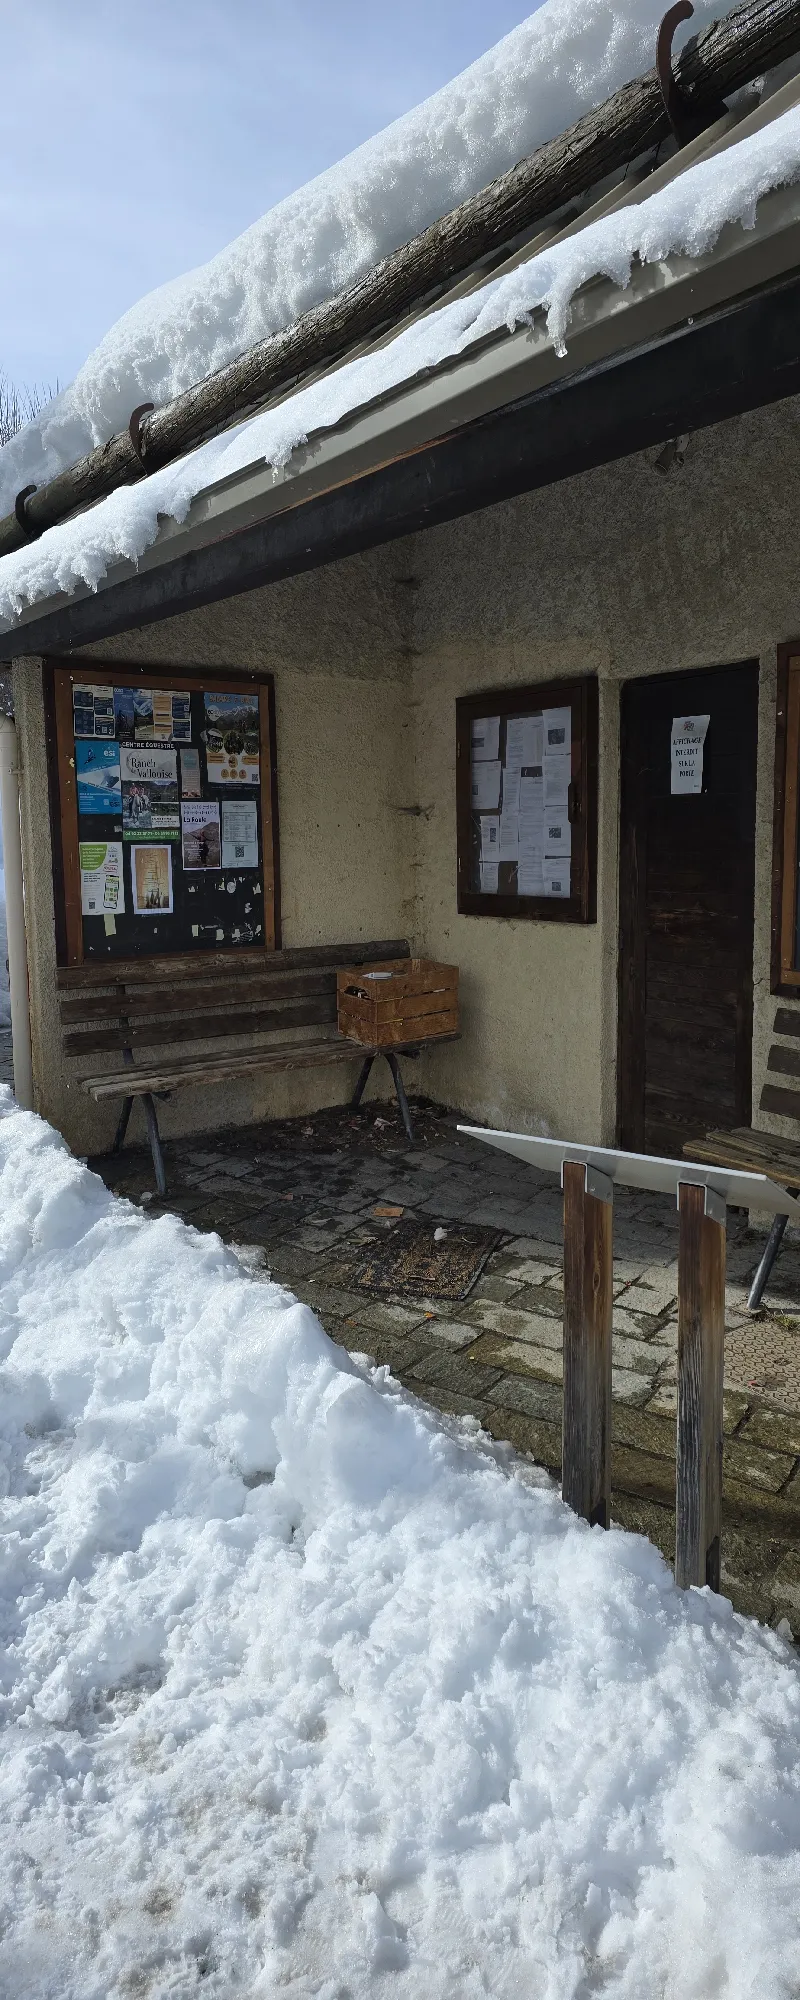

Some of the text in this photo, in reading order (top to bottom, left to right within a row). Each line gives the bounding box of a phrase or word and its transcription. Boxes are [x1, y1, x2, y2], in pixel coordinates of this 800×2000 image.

[675, 748, 698, 757] INTERDIT
[130, 757, 156, 768] Ranch
[137, 768, 173, 779] Vallouise
[679, 769, 695, 777] PORTE
